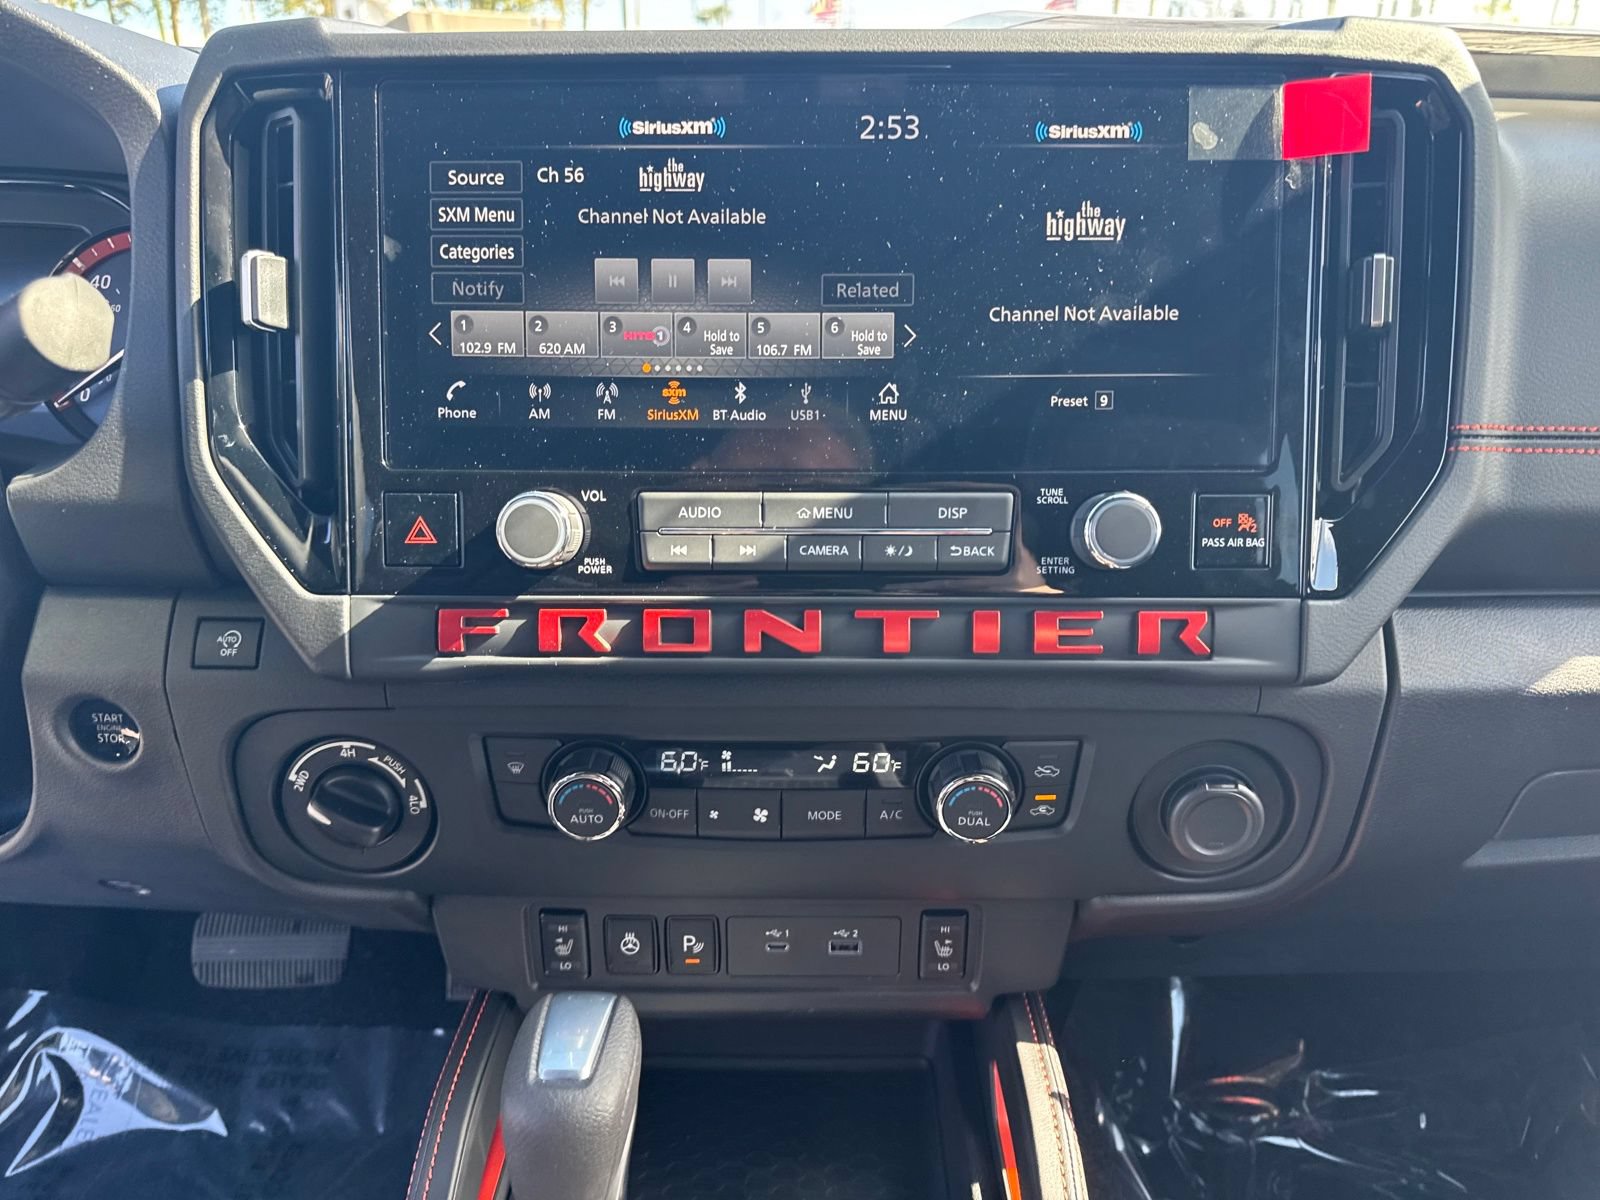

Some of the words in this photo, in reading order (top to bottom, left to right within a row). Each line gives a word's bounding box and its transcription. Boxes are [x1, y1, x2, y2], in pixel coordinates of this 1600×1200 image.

[859, 115, 920, 139] 2:53
[667, 157, 684, 173] the
[447, 170, 504, 186] Source
[536, 167, 559, 183] Ch
[564, 168, 584, 183] 56
[639, 166, 705, 192] highway
[438, 207, 470, 222] SXM
[475, 207, 515, 222] Menu
[1081, 200, 1101, 218] the
[578, 208, 648, 224] Channel
[653, 209, 683, 224] Not
[687, 208, 767, 224] Available
[1046, 210, 1126, 241] highway
[439, 243, 515, 264] Categories
[90, 274, 111, 289] 40
[452, 281, 504, 300] Notify
[836, 282, 900, 298] Related
[989, 306, 1059, 322] Channel
[1064, 306, 1095, 321] Not
[1100, 305, 1179, 321] Available
[459, 319, 467, 331] 1
[534, 320, 543, 332] 2
[609, 321, 617, 333] 3
[682, 321, 691, 333] 4
[757, 322, 765, 333] 5
[830, 322, 839, 333] 6
[703, 330, 727, 342] Hold
[729, 331, 740, 342] to
[851, 330, 874, 342] Hold
[876, 331, 888, 342] to
[459, 342, 492, 354] 102.9
[498, 342, 516, 354] FM
[538, 343, 561, 354] 620
[563, 343, 586, 354] AM
[710, 343, 734, 355] Save
[756, 344, 788, 356] 106.7
[793, 344, 812, 356] FM
[857, 343, 881, 356] Save
[80, 387, 91, 402] 0
[1050, 395, 1089, 407] Preset
[1099, 395, 1108, 407] 9
[437, 407, 477, 419] Phone
[528, 408, 551, 419] AM
[597, 409, 616, 420] FM
[647, 408, 699, 420] SiriusXM
[713, 409, 726, 420] BT
[729, 409, 767, 421] Audio
[790, 409, 820, 421] USB1
[869, 409, 908, 421] MENU
[581, 490, 607, 501] VOL
[1040, 488, 1064, 496] TUNE
[1036, 496, 1069, 504] SCROLL
[678, 506, 722, 519] AUDIO
[812, 507, 853, 519] MENU
[938, 507, 968, 519] DISP
[1212, 518, 1232, 528] OFF
[1201, 537, 1225, 547] PASS
[1227, 537, 1244, 547] AIR
[1245, 537, 1265, 547] BAG
[799, 545, 849, 556] CAMERA
[963, 546, 995, 556] BACK
[584, 557, 606, 565] PUSH
[1041, 557, 1070, 565] ENTER
[578, 565, 612, 574] POWER
[1036, 566, 1075, 574] SETTING
[438, 608, 1211, 656] FRONTIER
[220, 648, 238, 657] OFF
[91, 713, 123, 722] START
[340, 748, 356, 758] 4H
[383, 755, 406, 775] PUSH
[293, 770, 310, 792] 2WD
[409, 795, 420, 815] 4LO
[570, 814, 604, 824] AUTO
[807, 810, 843, 821] MODE
[880, 809, 904, 820] A/C
[957, 816, 991, 827] DUAL
[558, 925, 568, 933] HI
[852, 930, 859, 938] 2
[560, 962, 572, 970] LO
[937, 963, 950, 971] LO
